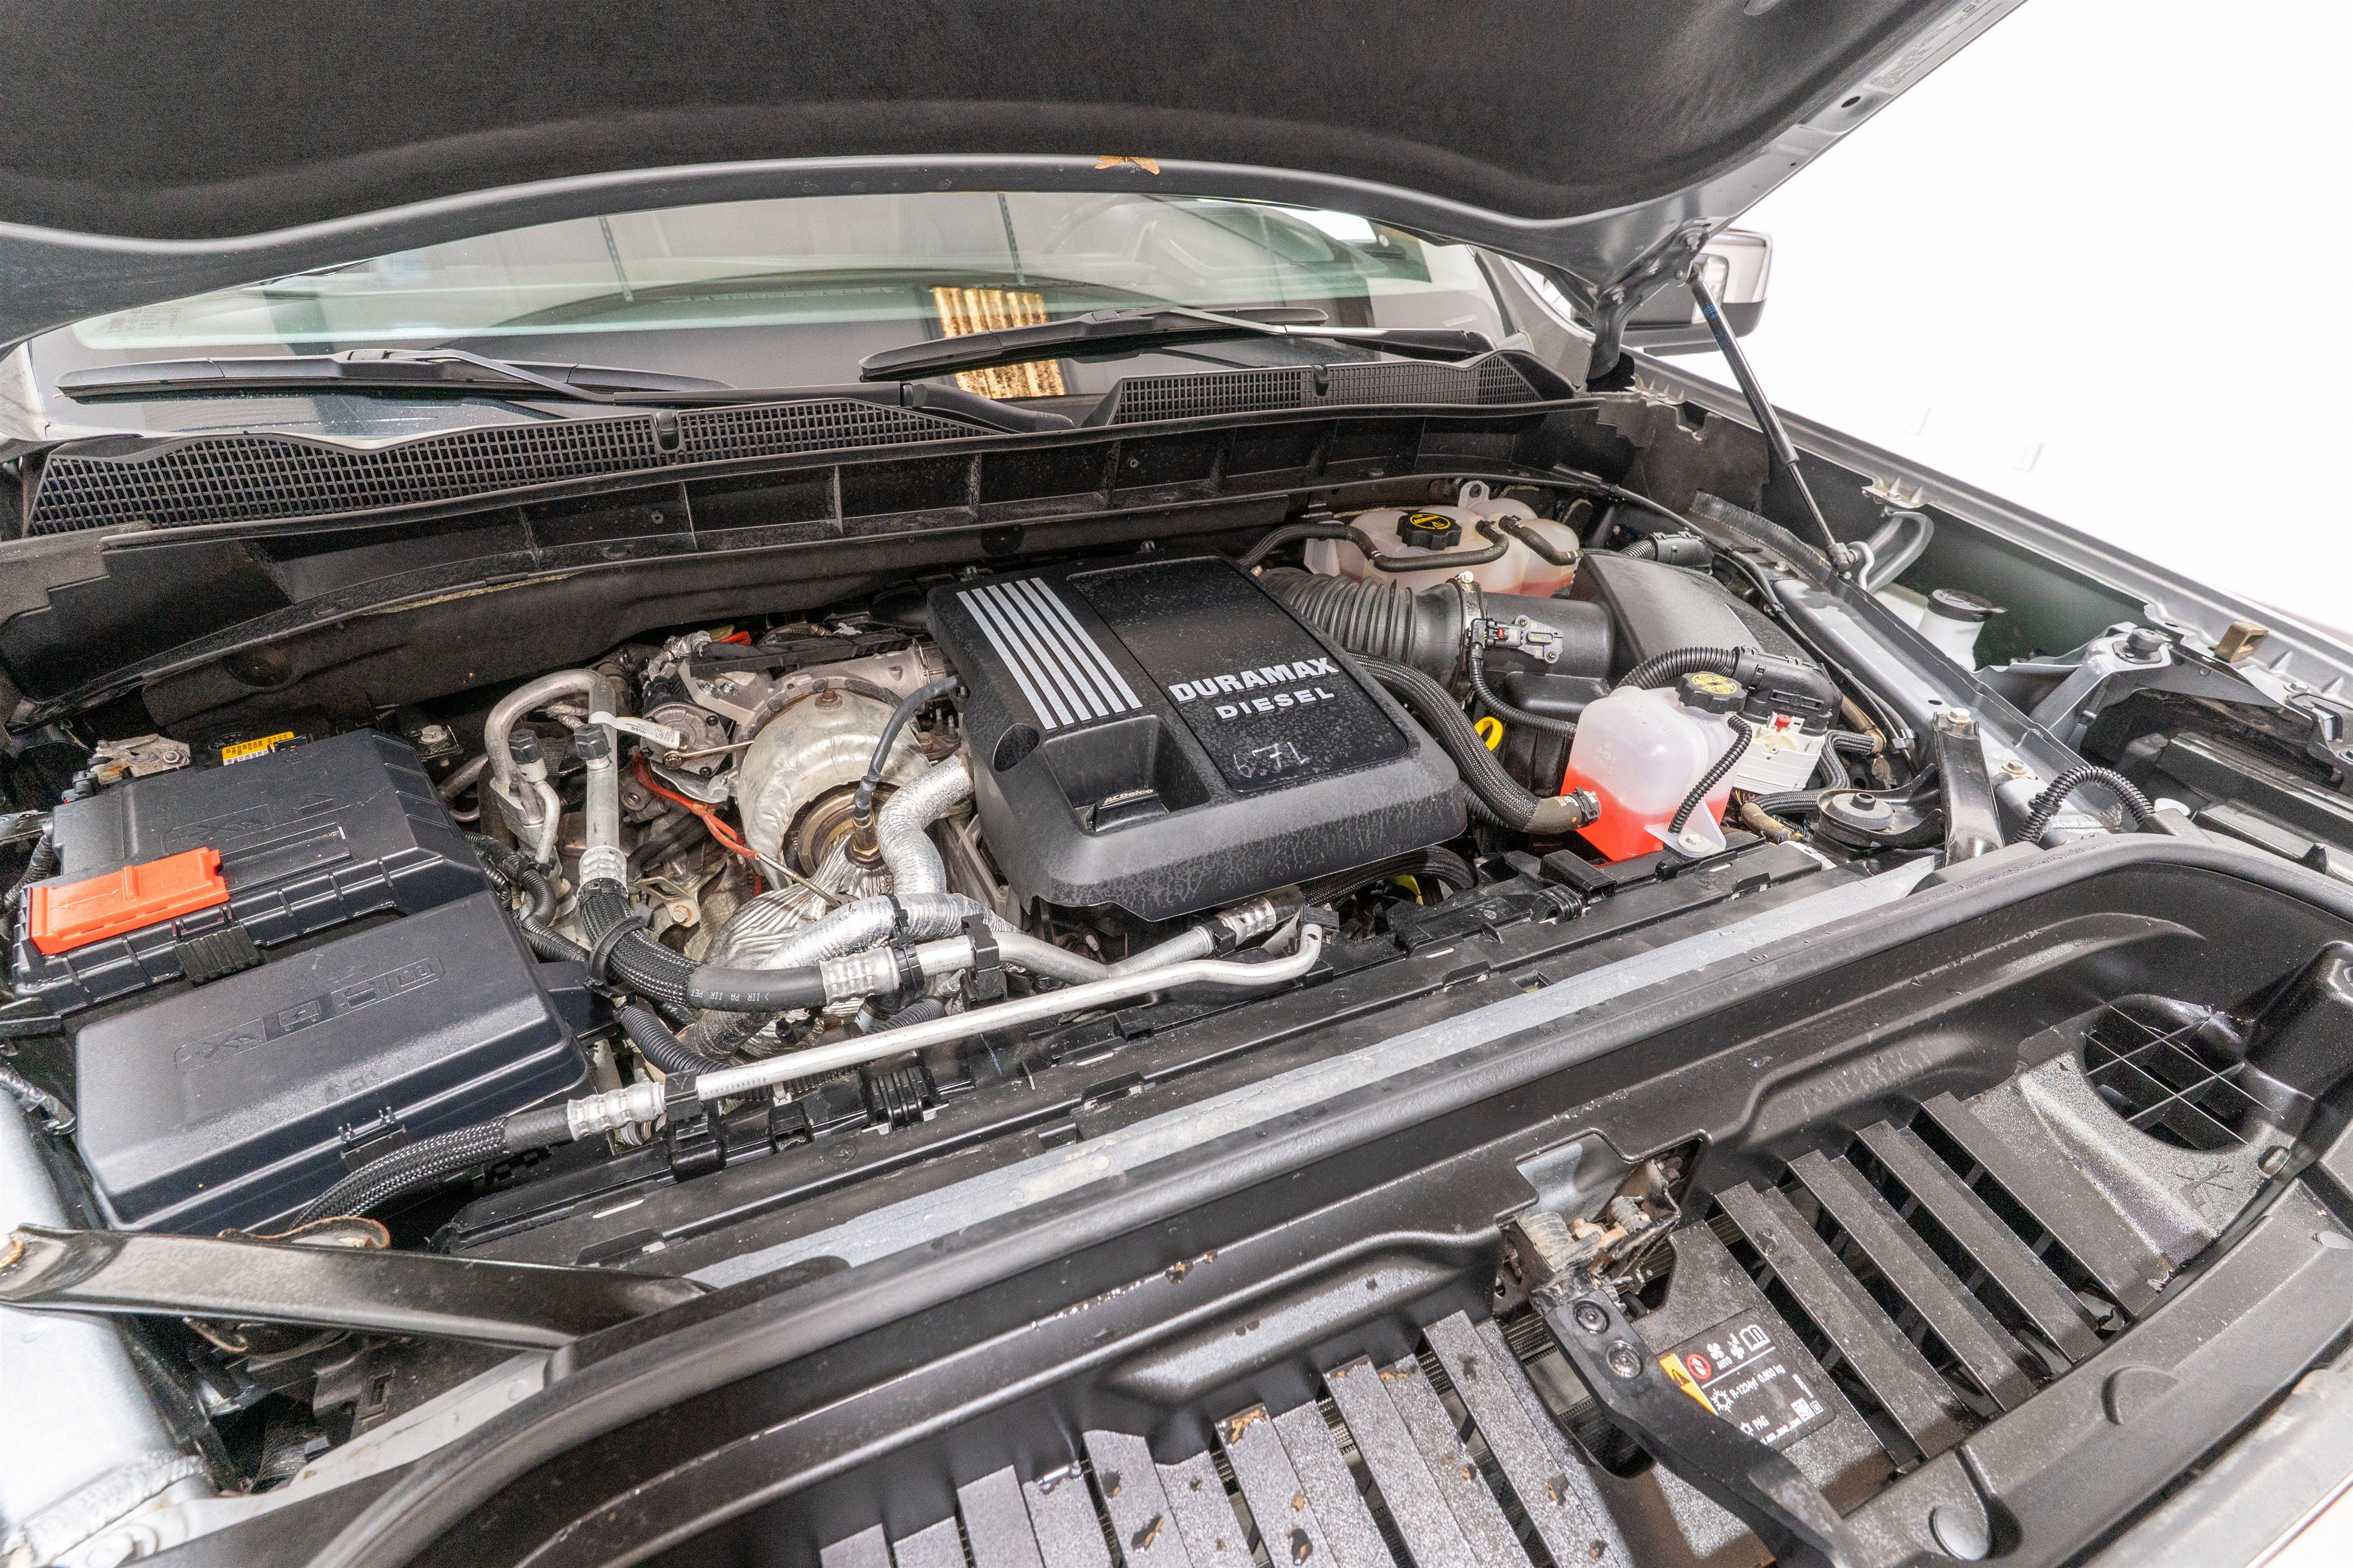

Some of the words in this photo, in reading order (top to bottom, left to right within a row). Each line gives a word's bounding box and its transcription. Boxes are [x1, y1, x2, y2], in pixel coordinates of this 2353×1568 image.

[1168, 657, 1339, 704] DURAMAX
[1215, 687, 1334, 721] DIESEL
[1102, 789, 1154, 806] ACDelco
[690, 988, 704, 998] PET
[710, 991, 723, 1001] IIR
[730, 992, 740, 1001] PA
[747, 992, 760, 1001] IIR
[1716, 1355, 1733, 1370] AUTO
[1729, 1377, 1759, 1399] R-1234yf
[1772, 1364, 1786, 1374] kg
[1752, 1415, 1770, 1431] PAG
